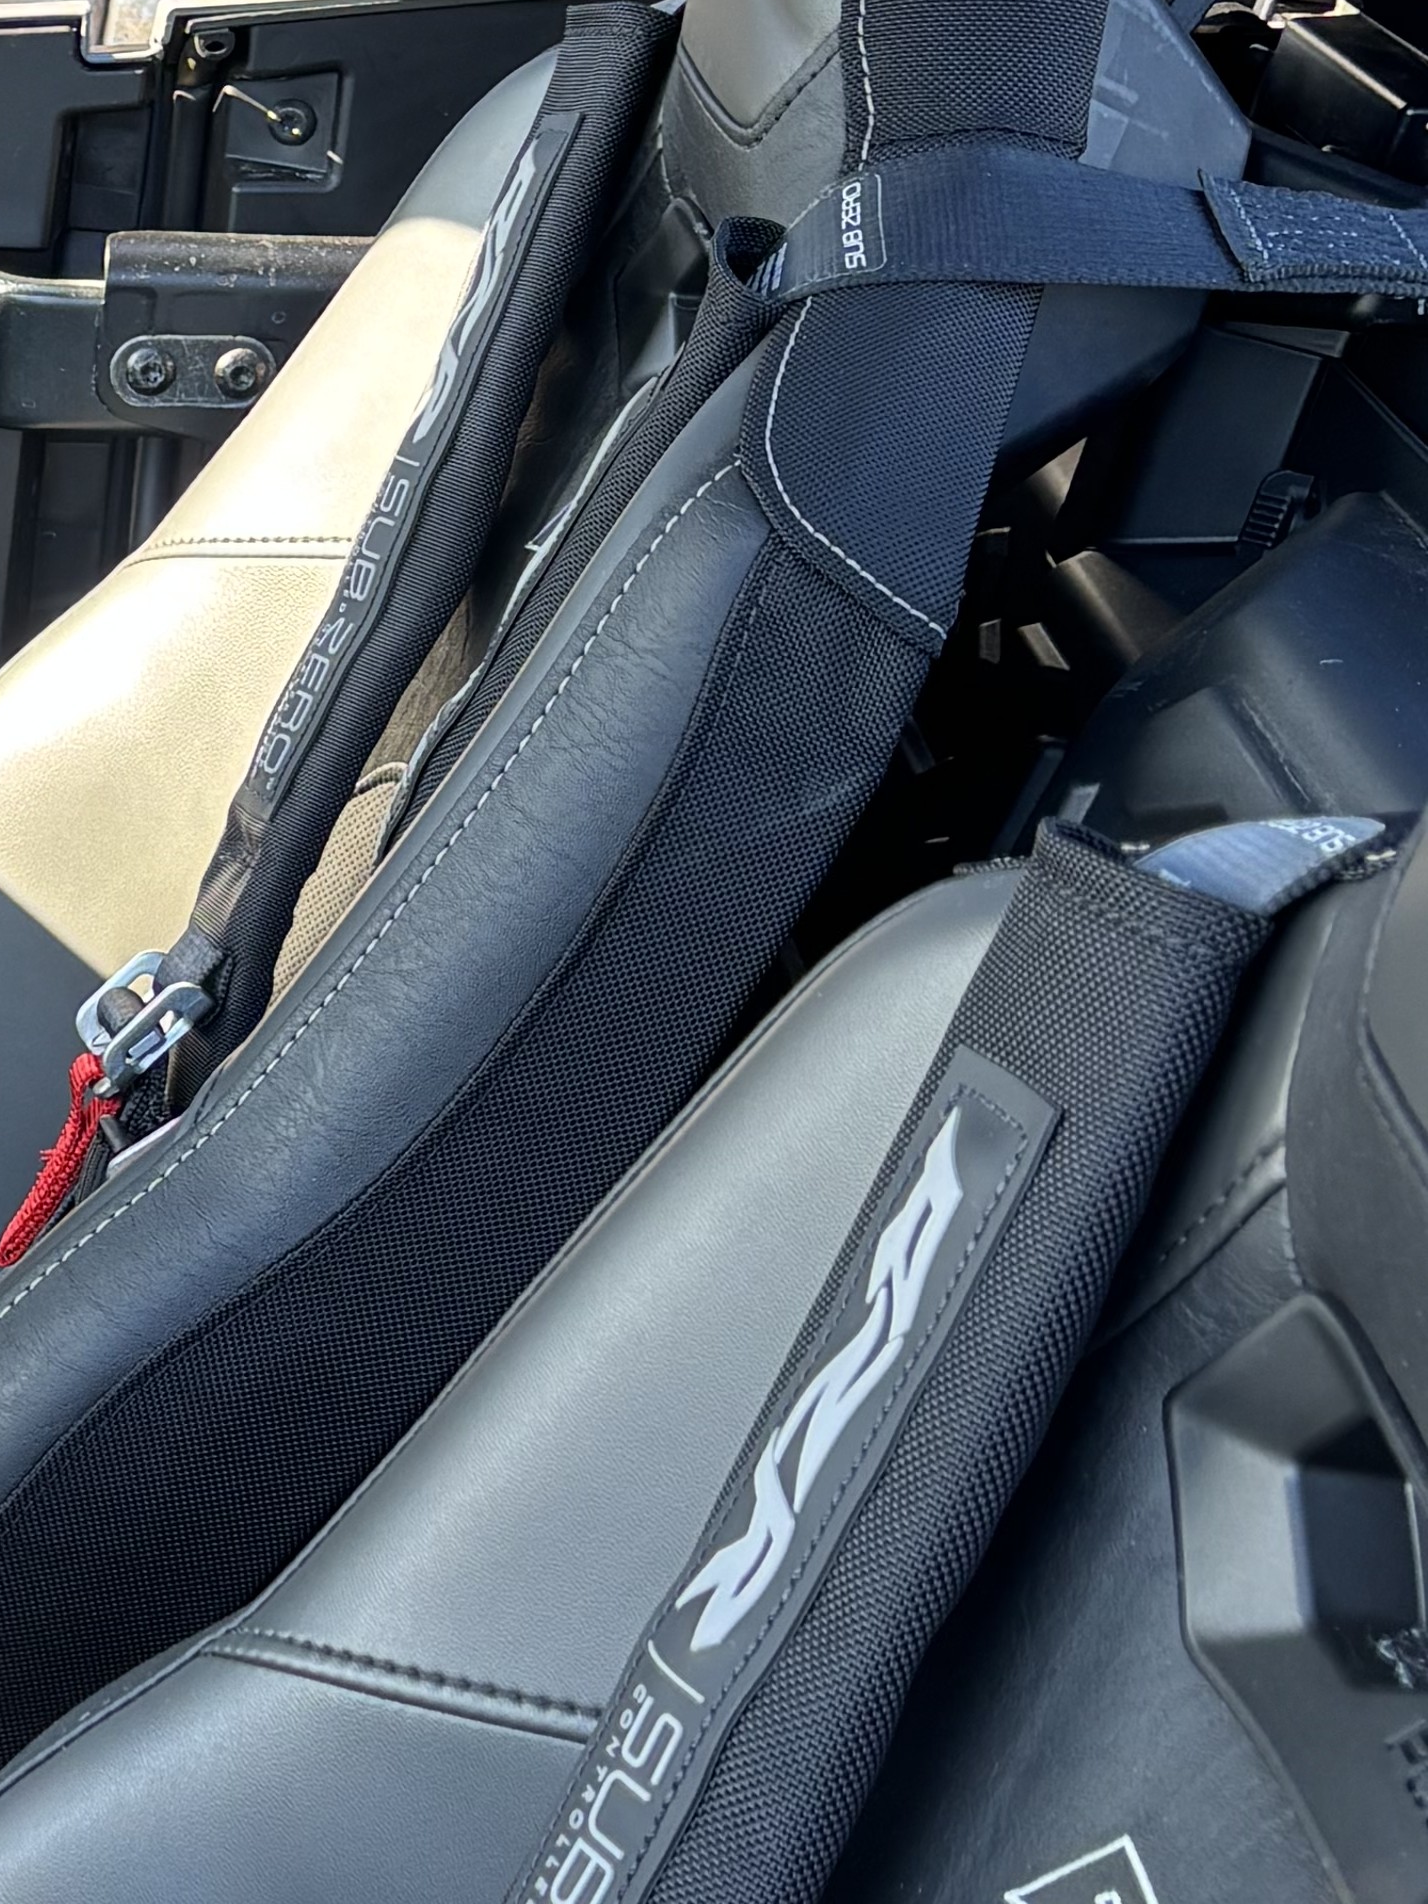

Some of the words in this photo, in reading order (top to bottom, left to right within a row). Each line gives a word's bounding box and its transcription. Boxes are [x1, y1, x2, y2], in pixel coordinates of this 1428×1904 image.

[841, 181, 862, 230] ZERO
[842, 229, 867, 270] SUB
[350, 474, 410, 602] SUB
[674, 1104, 964, 1653] RZR
